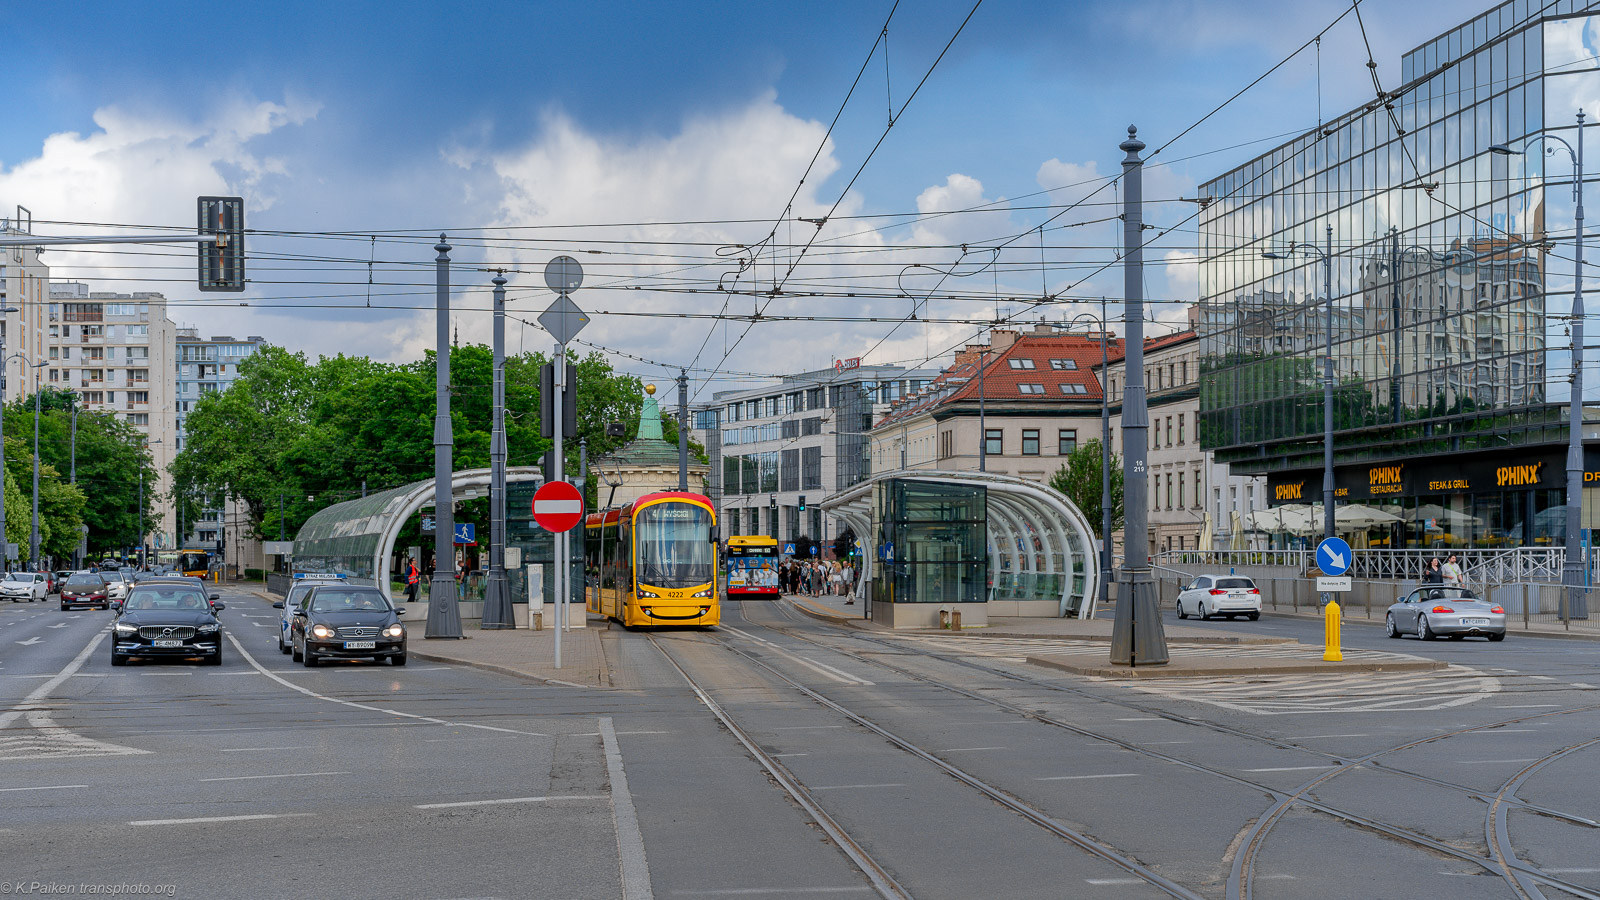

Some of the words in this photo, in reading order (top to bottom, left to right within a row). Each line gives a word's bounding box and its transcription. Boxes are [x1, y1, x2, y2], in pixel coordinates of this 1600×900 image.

[1369, 466, 1401, 484] SPHINX
[1496, 465, 1538, 486] SPHINX
[1275, 484, 1302, 500] SPHINX
[1370, 484, 1403, 494] RESTAURACJA
[1429, 480, 1447, 490] STEAK
[1447, 480, 1452, 489] &
[1452, 479, 1470, 489] GRILL
